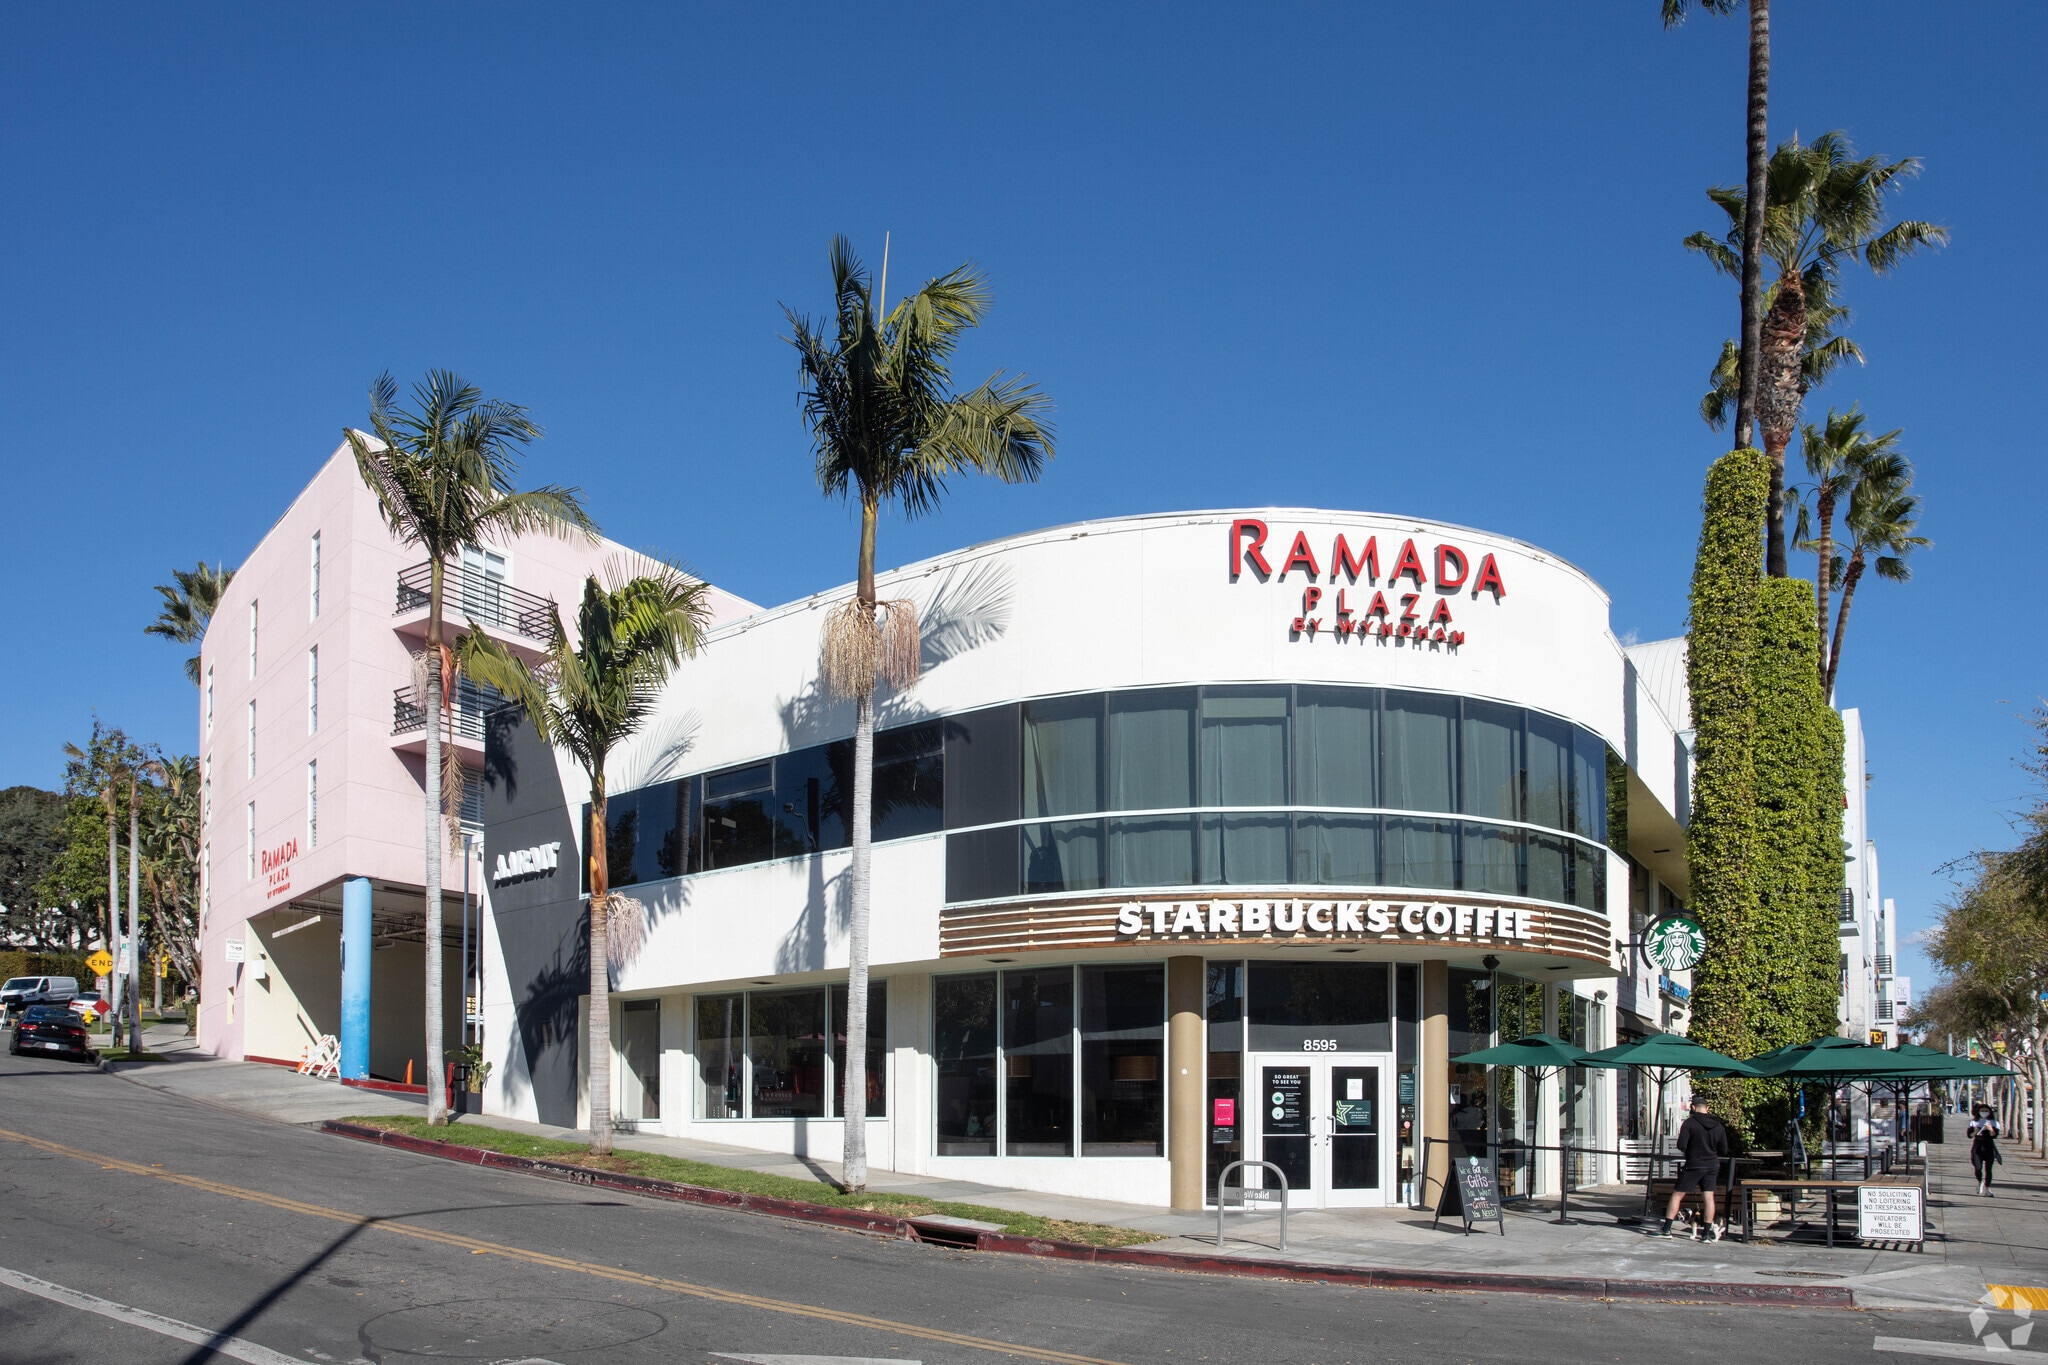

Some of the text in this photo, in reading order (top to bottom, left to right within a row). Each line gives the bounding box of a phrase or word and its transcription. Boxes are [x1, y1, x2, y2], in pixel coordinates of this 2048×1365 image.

[1231, 518, 1507, 599] RAMADA
[1304, 586, 1453, 623] PLAZA
[1293, 617, 1465, 645] BY WYNDHAM
[261, 837, 298, 875] RAMADA
[269, 867, 289, 887] PLAZA
[1118, 902, 1532, 939] STARBUCKS COFFEE
[1303, 1039, 1337, 1051] 8595
